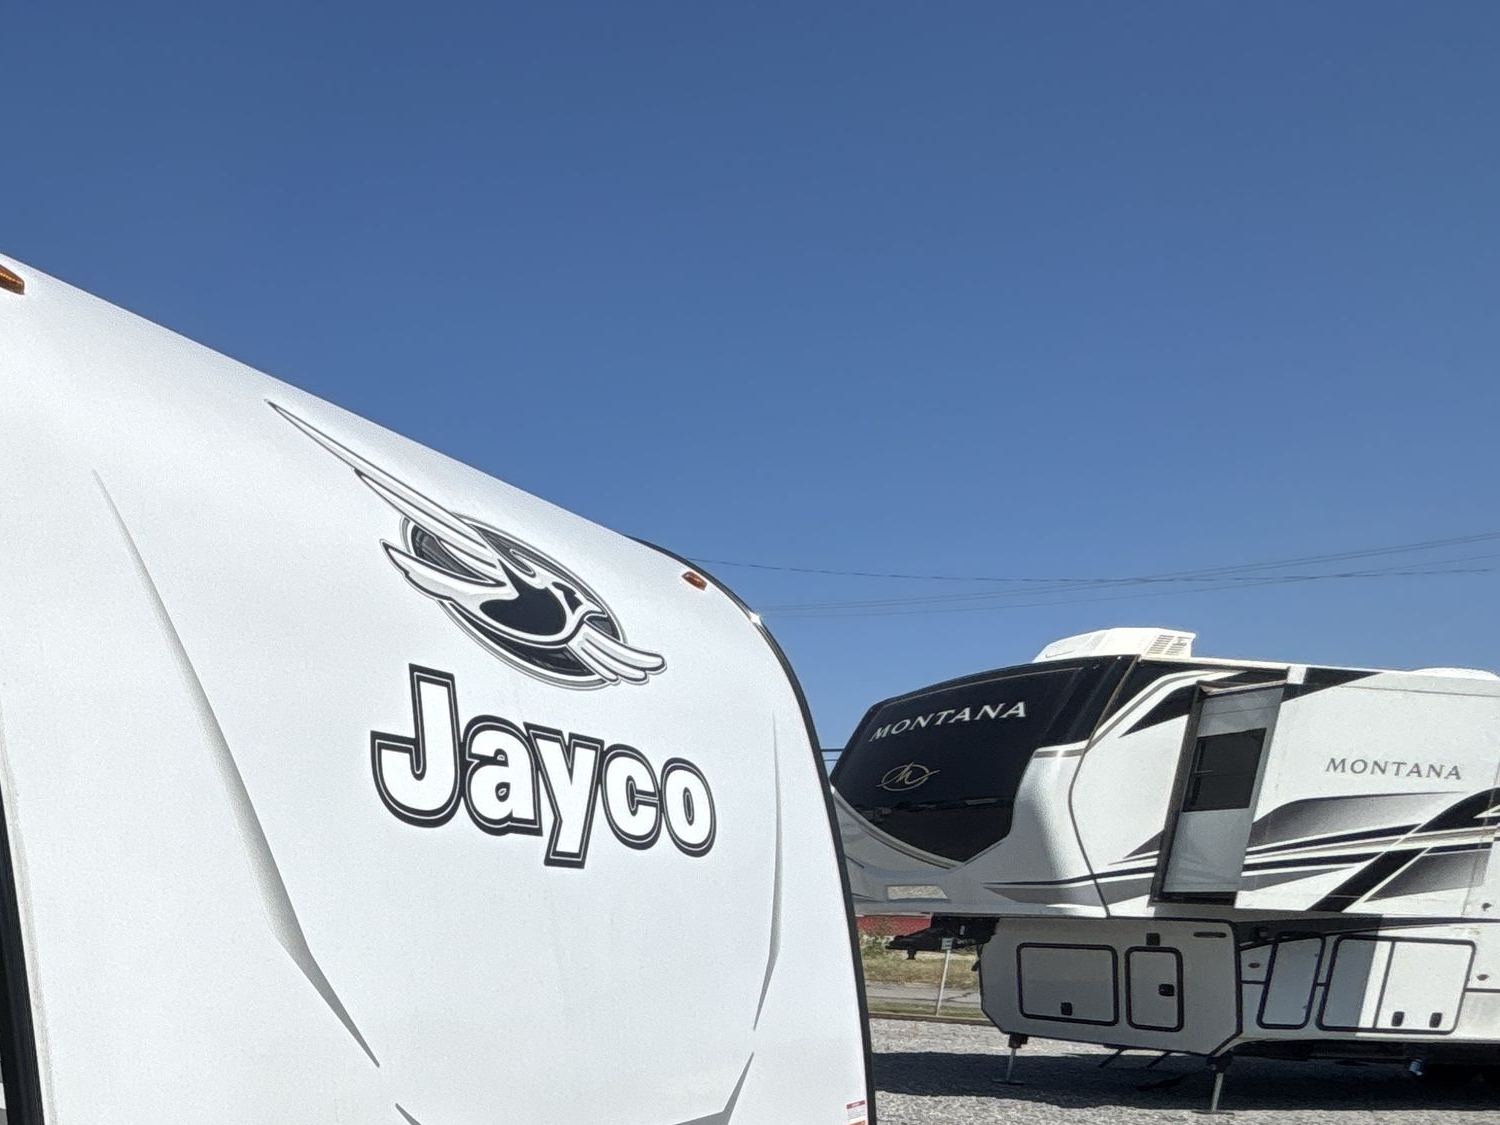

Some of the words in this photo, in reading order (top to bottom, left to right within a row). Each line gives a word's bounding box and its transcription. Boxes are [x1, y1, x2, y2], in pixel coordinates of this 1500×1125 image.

[868, 701, 1027, 743] MONTANA
[370, 663, 717, 869] Jayco
[1325, 757, 1462, 781] MONTANA
